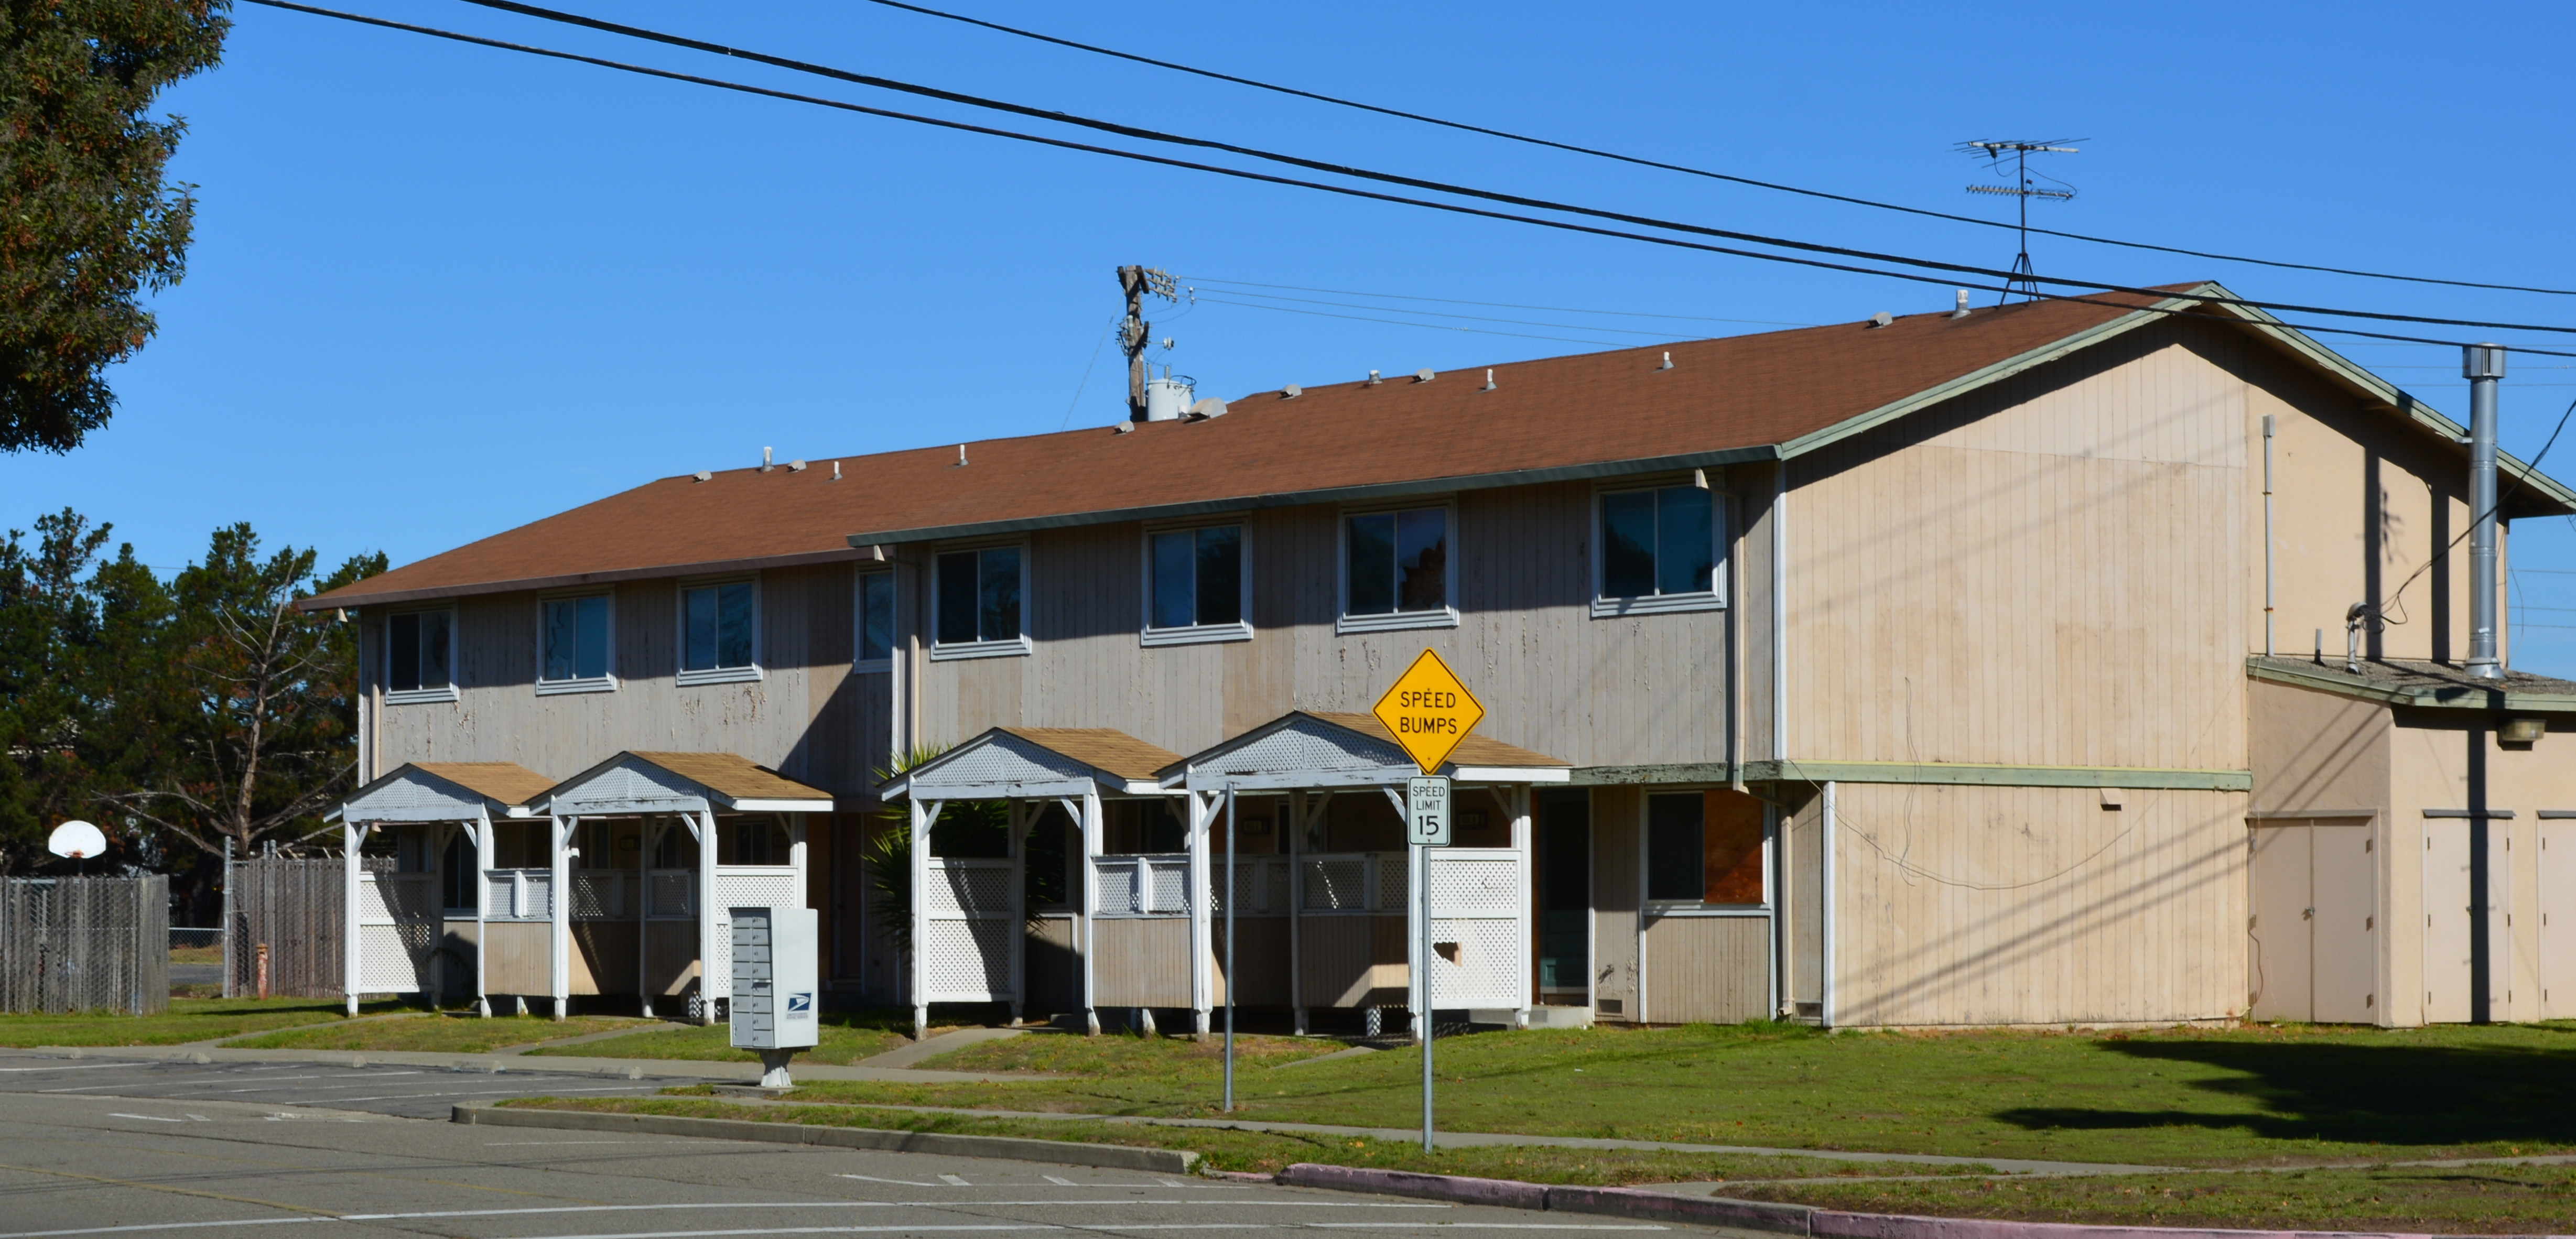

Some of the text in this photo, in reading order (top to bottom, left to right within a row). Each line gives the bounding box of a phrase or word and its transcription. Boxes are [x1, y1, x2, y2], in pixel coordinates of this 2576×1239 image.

[1400, 691, 1456, 708] SPEED
[1400, 716, 1457, 734] BUMPS
[1413, 786, 1445, 797] SPEED
[1416, 800, 1441, 811] LIMIT
[1418, 815, 1439, 835] 15
